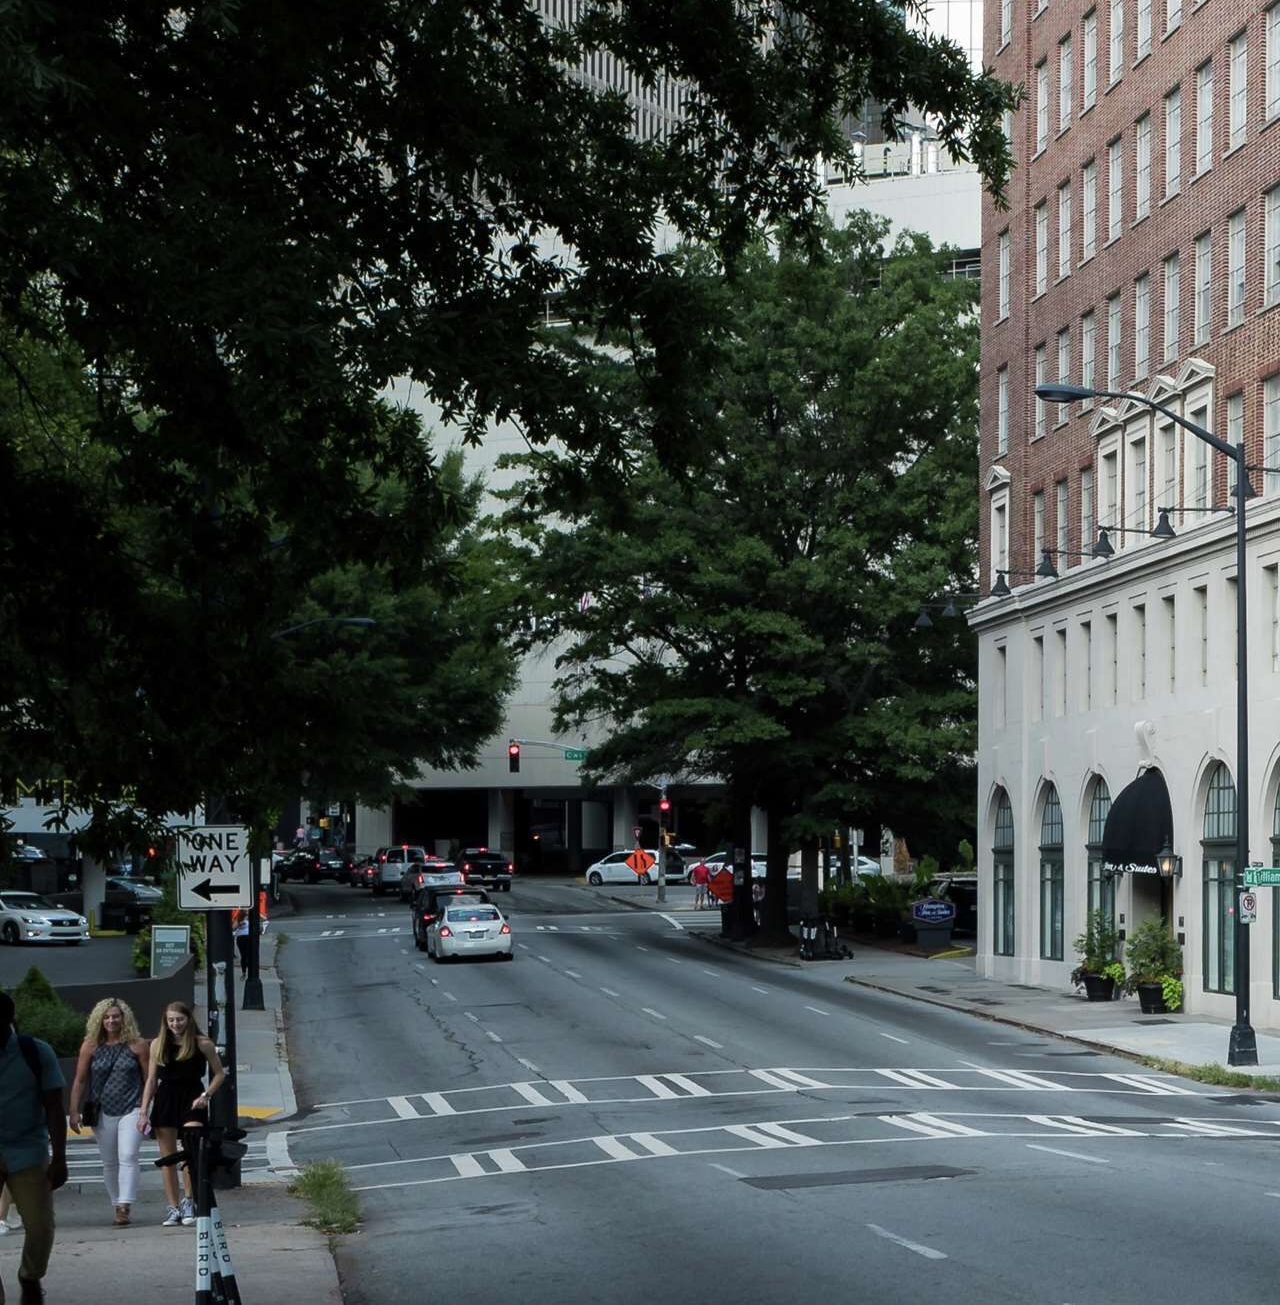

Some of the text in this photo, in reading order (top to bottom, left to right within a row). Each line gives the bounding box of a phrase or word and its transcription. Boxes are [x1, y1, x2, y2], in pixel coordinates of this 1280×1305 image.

[191, 832, 239, 851] ONE
[190, 855, 240, 873] WAY
[1125, 862, 1157, 874] Suites
[214, 1221, 231, 1263] BIRD
[198, 1230, 209, 1277] BIRD
